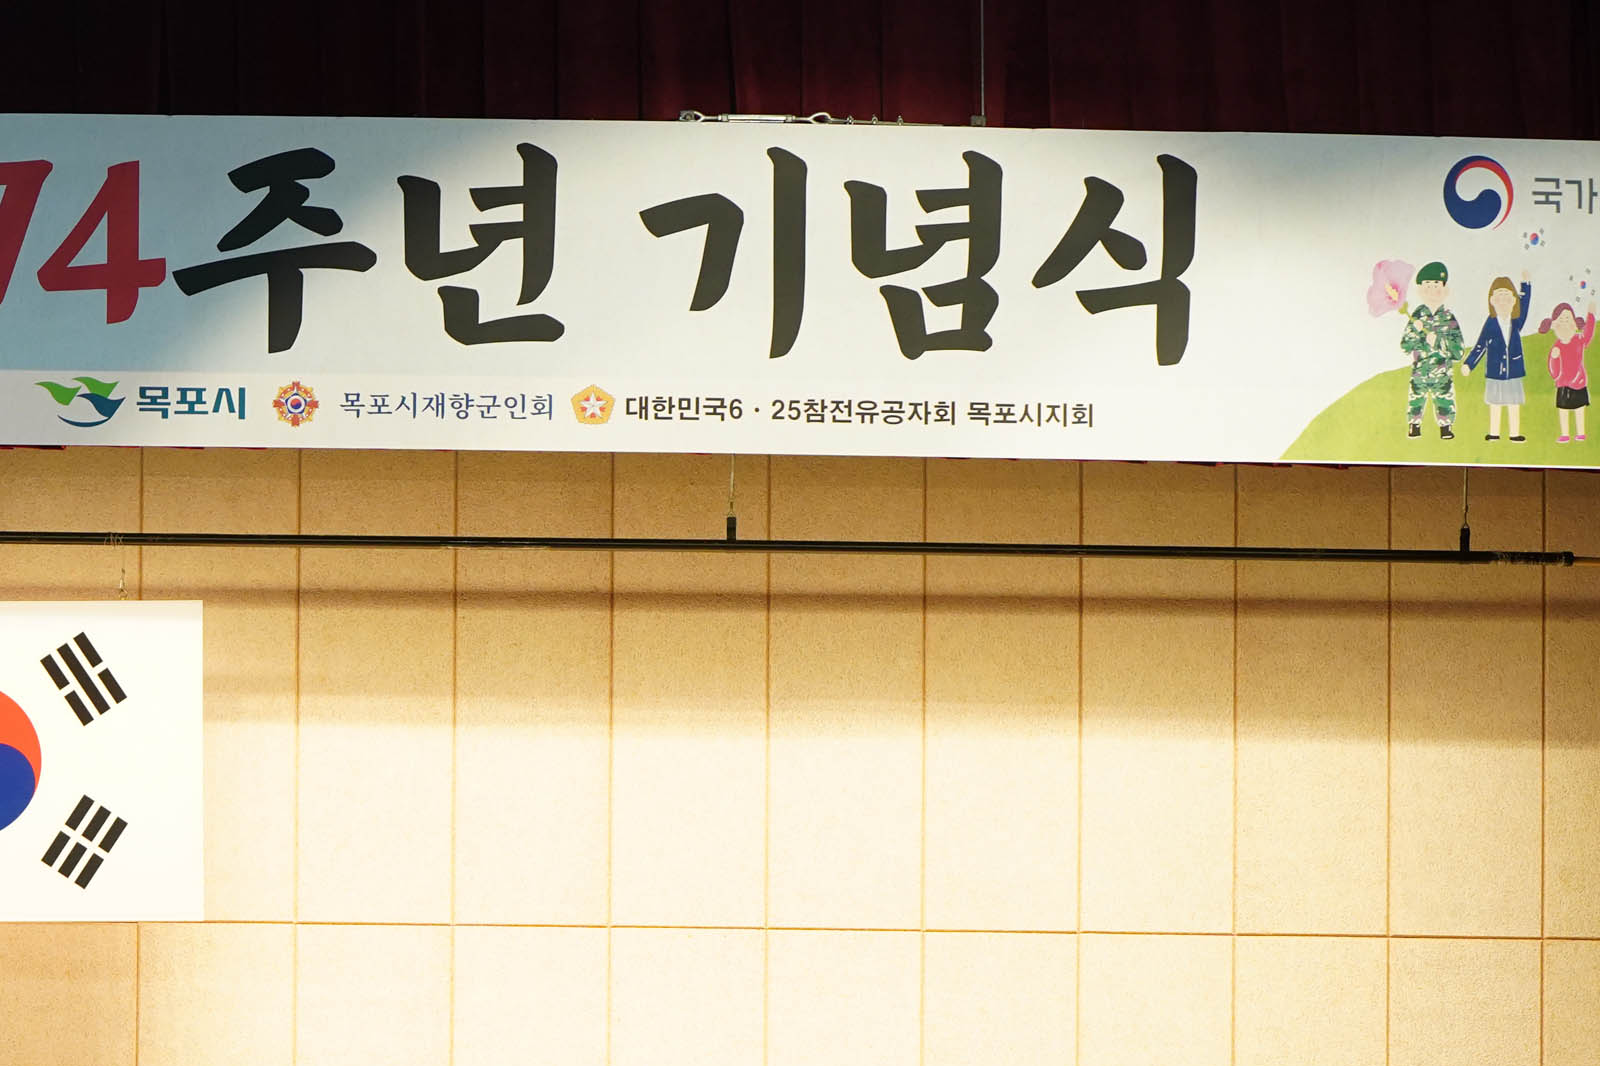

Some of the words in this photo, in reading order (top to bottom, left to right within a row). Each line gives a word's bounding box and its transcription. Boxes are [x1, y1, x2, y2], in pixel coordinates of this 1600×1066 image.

[638, 145, 1199, 366] 기념식
[136, 386, 246, 420] 목포시
[339, 391, 554, 420] 목포시재향군인회
[967, 401, 1095, 428] 목포시지회
